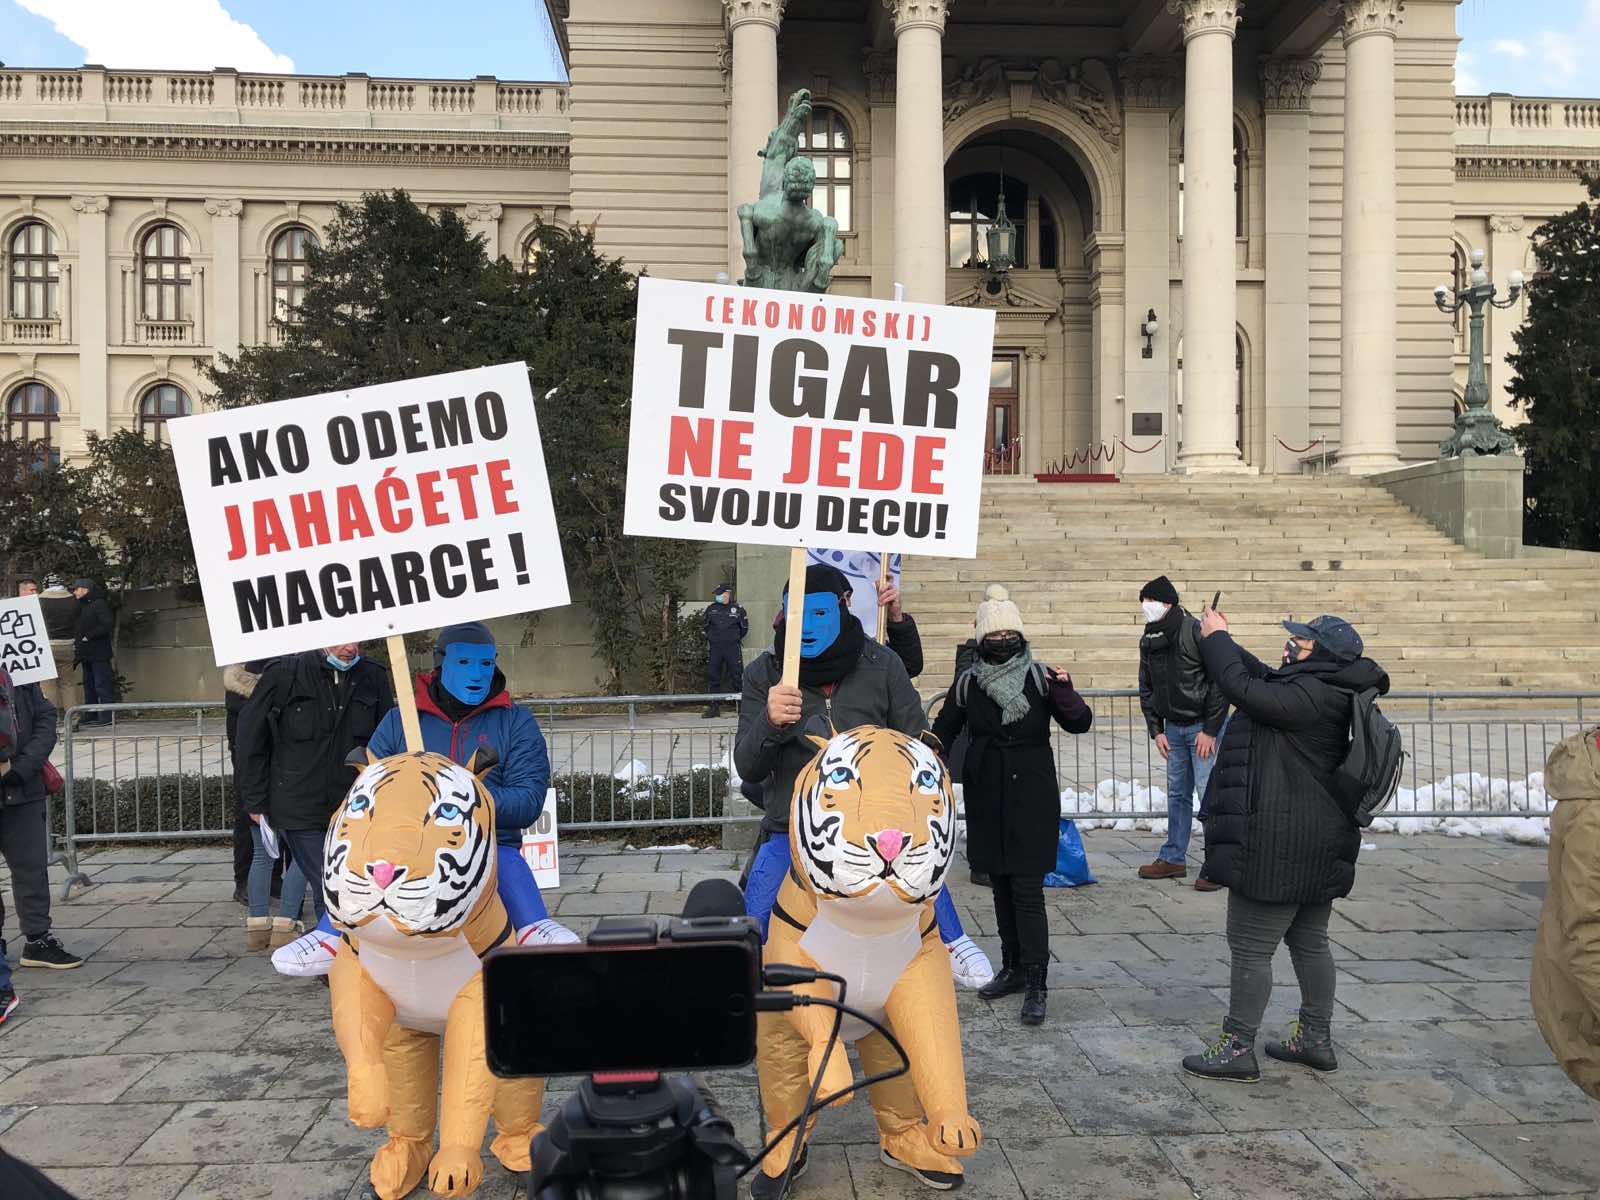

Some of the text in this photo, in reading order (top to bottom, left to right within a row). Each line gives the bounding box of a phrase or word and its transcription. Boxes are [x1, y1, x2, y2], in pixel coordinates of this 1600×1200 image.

[705, 296, 931, 342] (EKONOMSKI)
[667, 328, 960, 430] TIGAR
[208, 391, 508, 487] AKO ODEMO
[668, 416, 946, 495] NE JEDE
[223, 459, 519, 561] JAHAĆETE
[658, 483, 949, 540] SVOJU DECU!
[232, 537, 499, 634] MAGARCE
[0, 639, 43, 659] AO,
